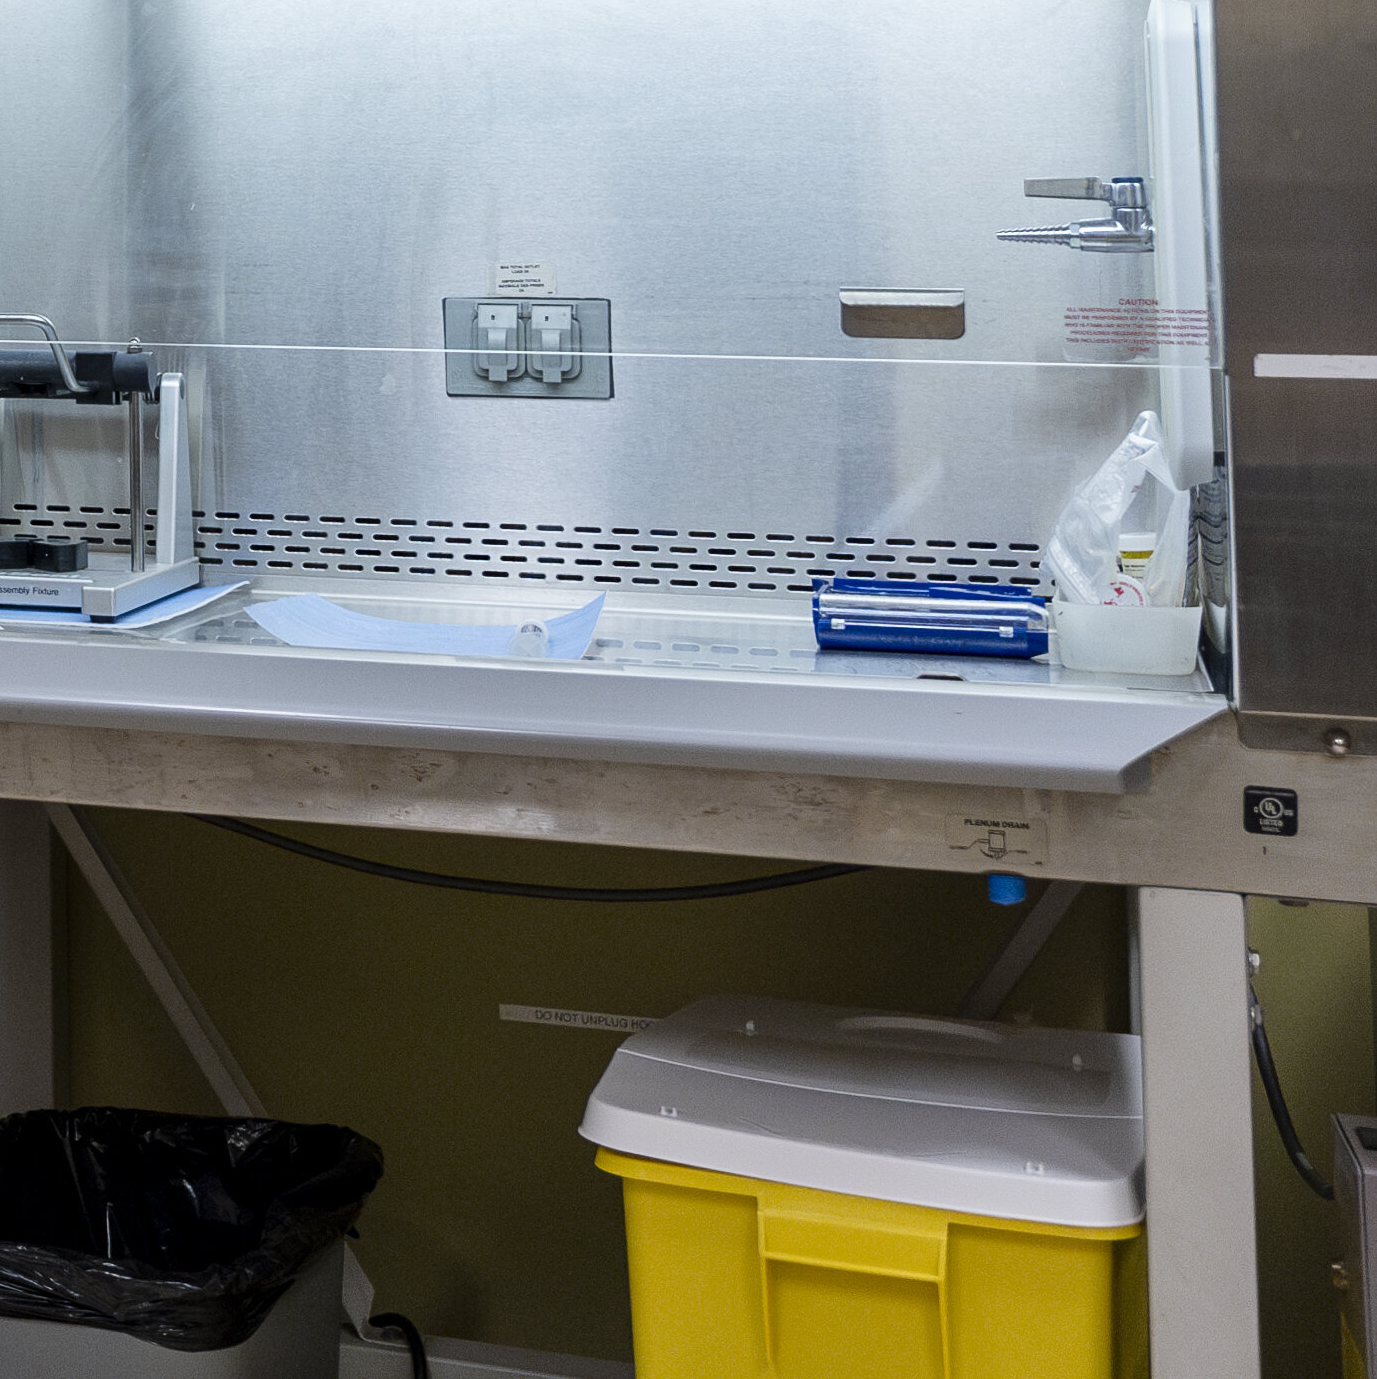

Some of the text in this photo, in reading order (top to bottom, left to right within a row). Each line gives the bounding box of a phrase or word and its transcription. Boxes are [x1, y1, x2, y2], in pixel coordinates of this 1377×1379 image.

[1118, 298, 1159, 306] CAUTION
[33, 587, 59, 596] Fixture
[964, 819, 1030, 830] PLENUM DRAIN
[535, 1009, 551, 1020] DO
[555, 1011, 579, 1024] NOT
[582, 1015, 628, 1029] UNPLUG
